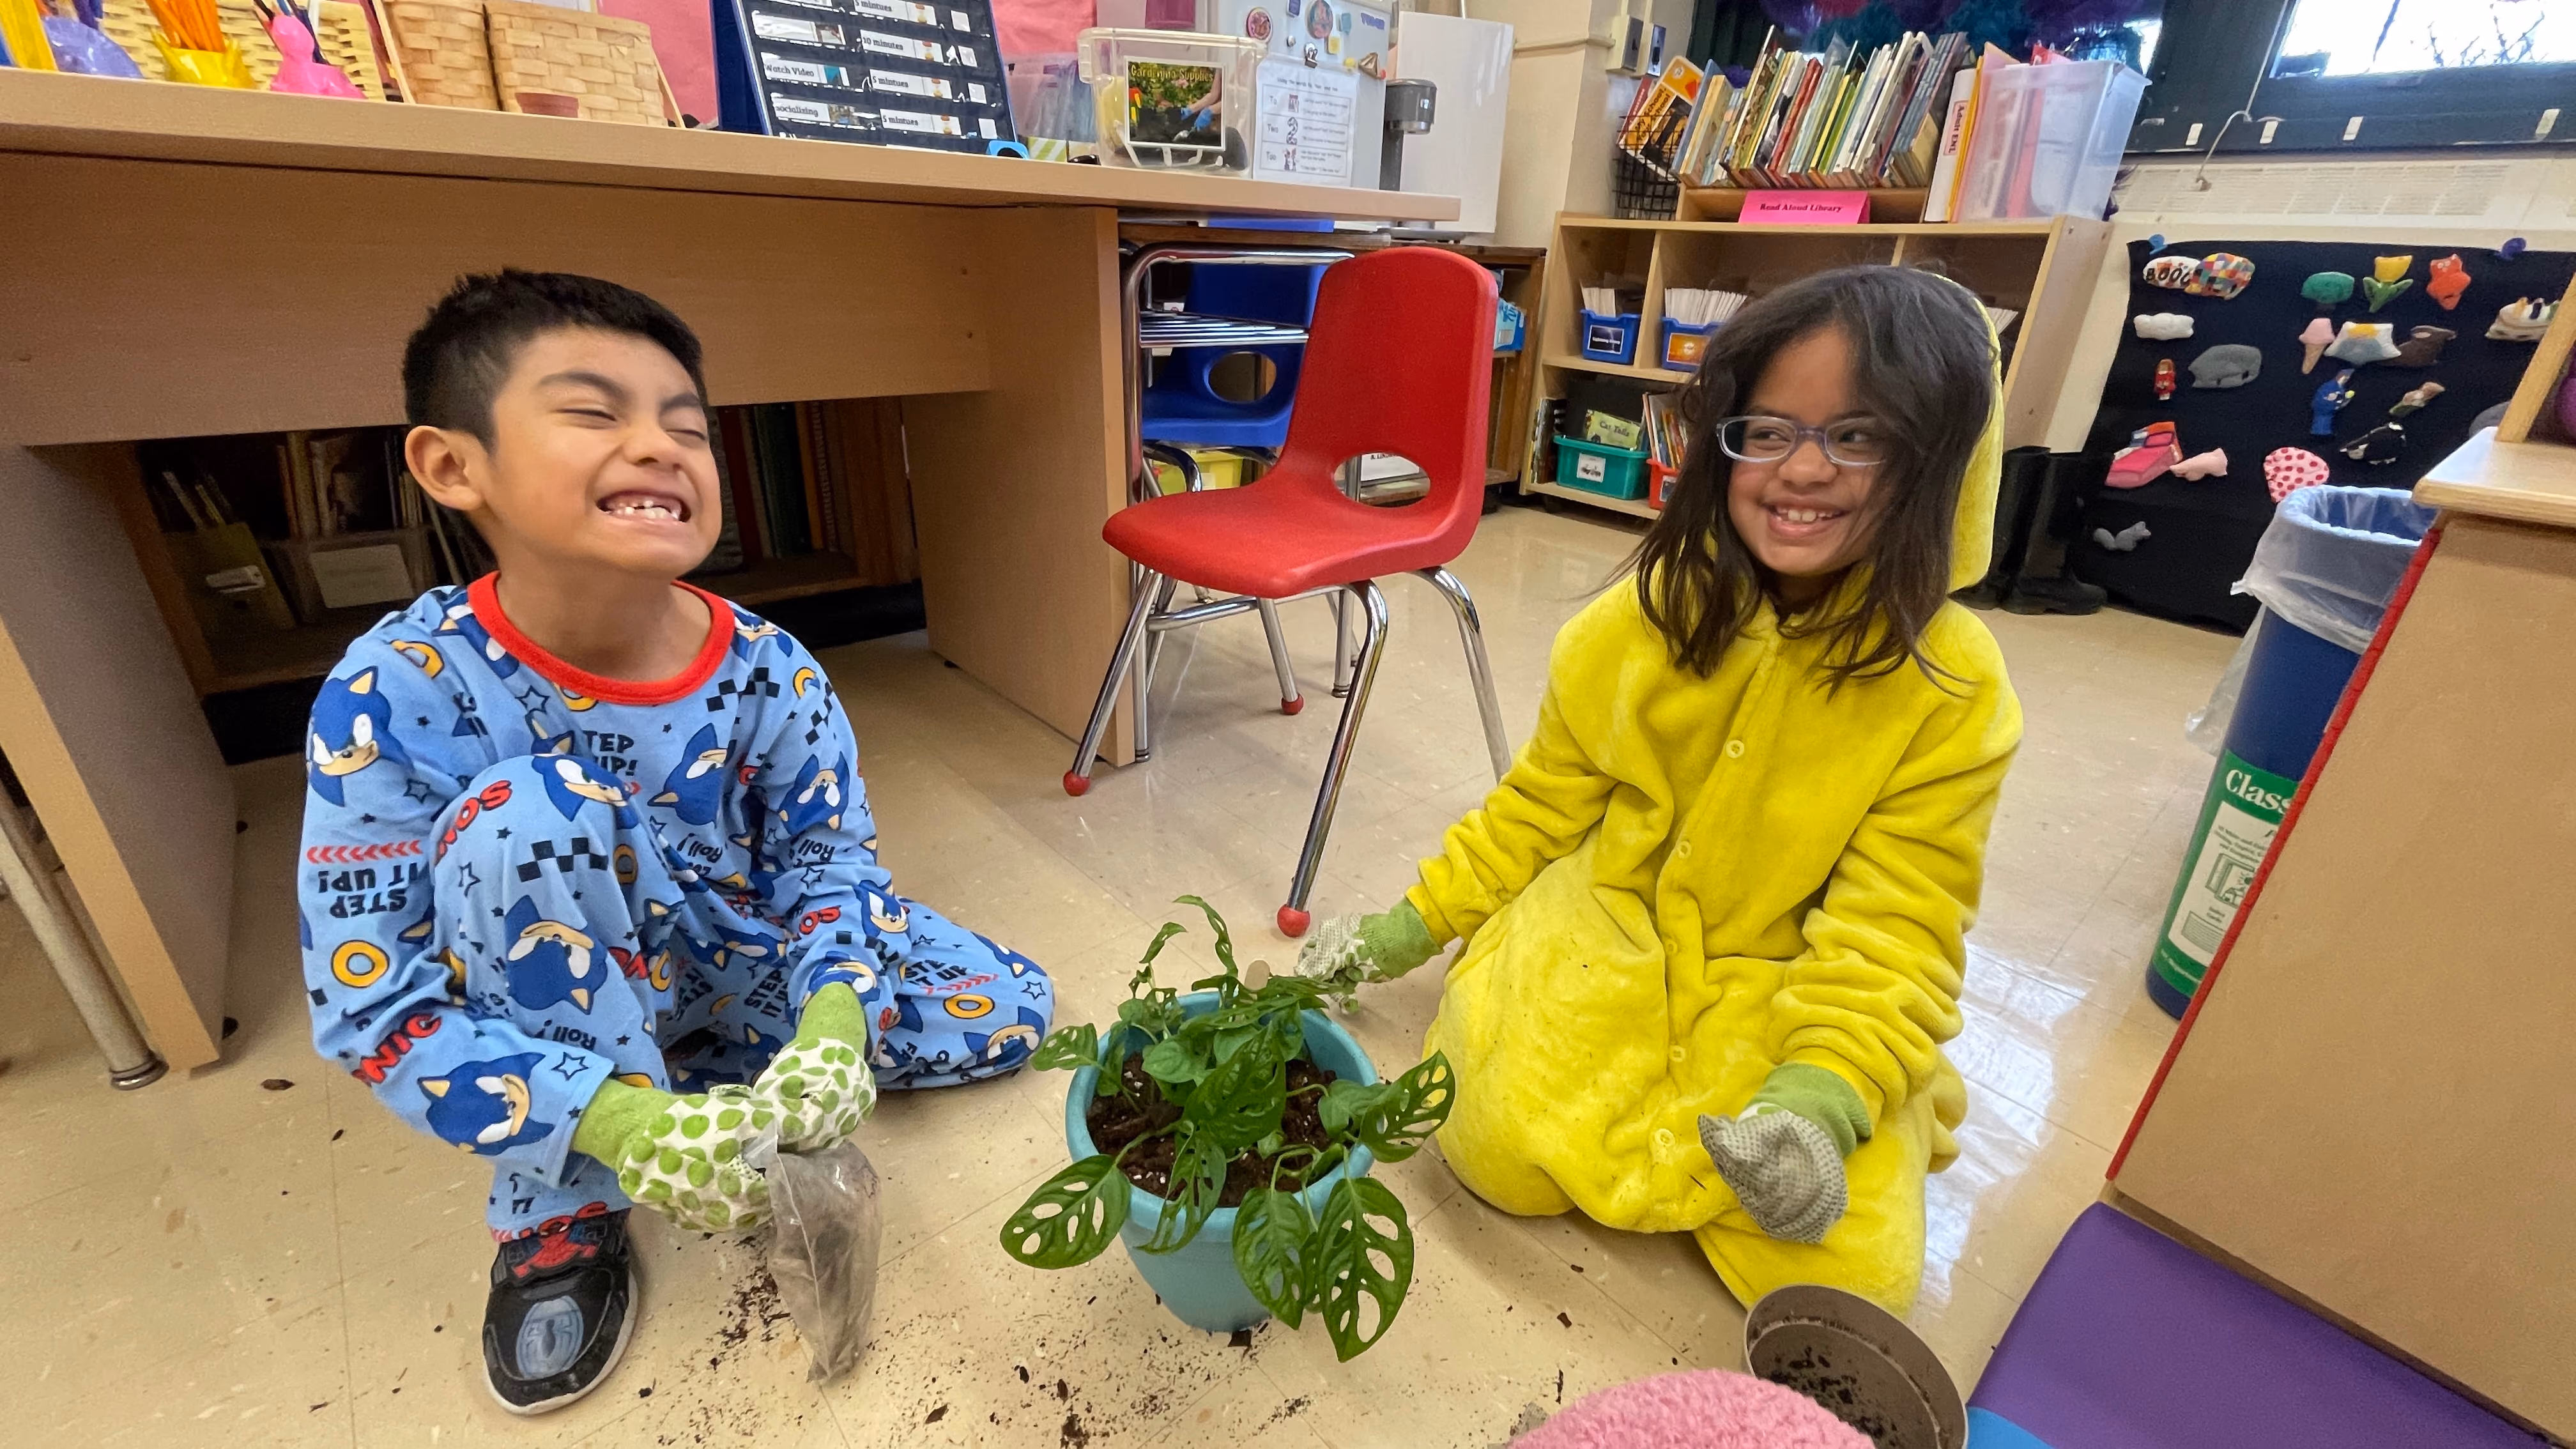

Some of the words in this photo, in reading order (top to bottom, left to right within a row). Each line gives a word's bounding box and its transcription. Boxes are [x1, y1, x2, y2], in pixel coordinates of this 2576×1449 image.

[792, 66, 815, 77] Video
[1131, 64, 1176, 81] Gardening
[1179, 68, 1213, 82] Supplies
[1759, 203, 1781, 211] Read
[1809, 204, 1844, 213] Library
[318, 868, 376, 894] UP!
[329, 887, 408, 919] STEP
